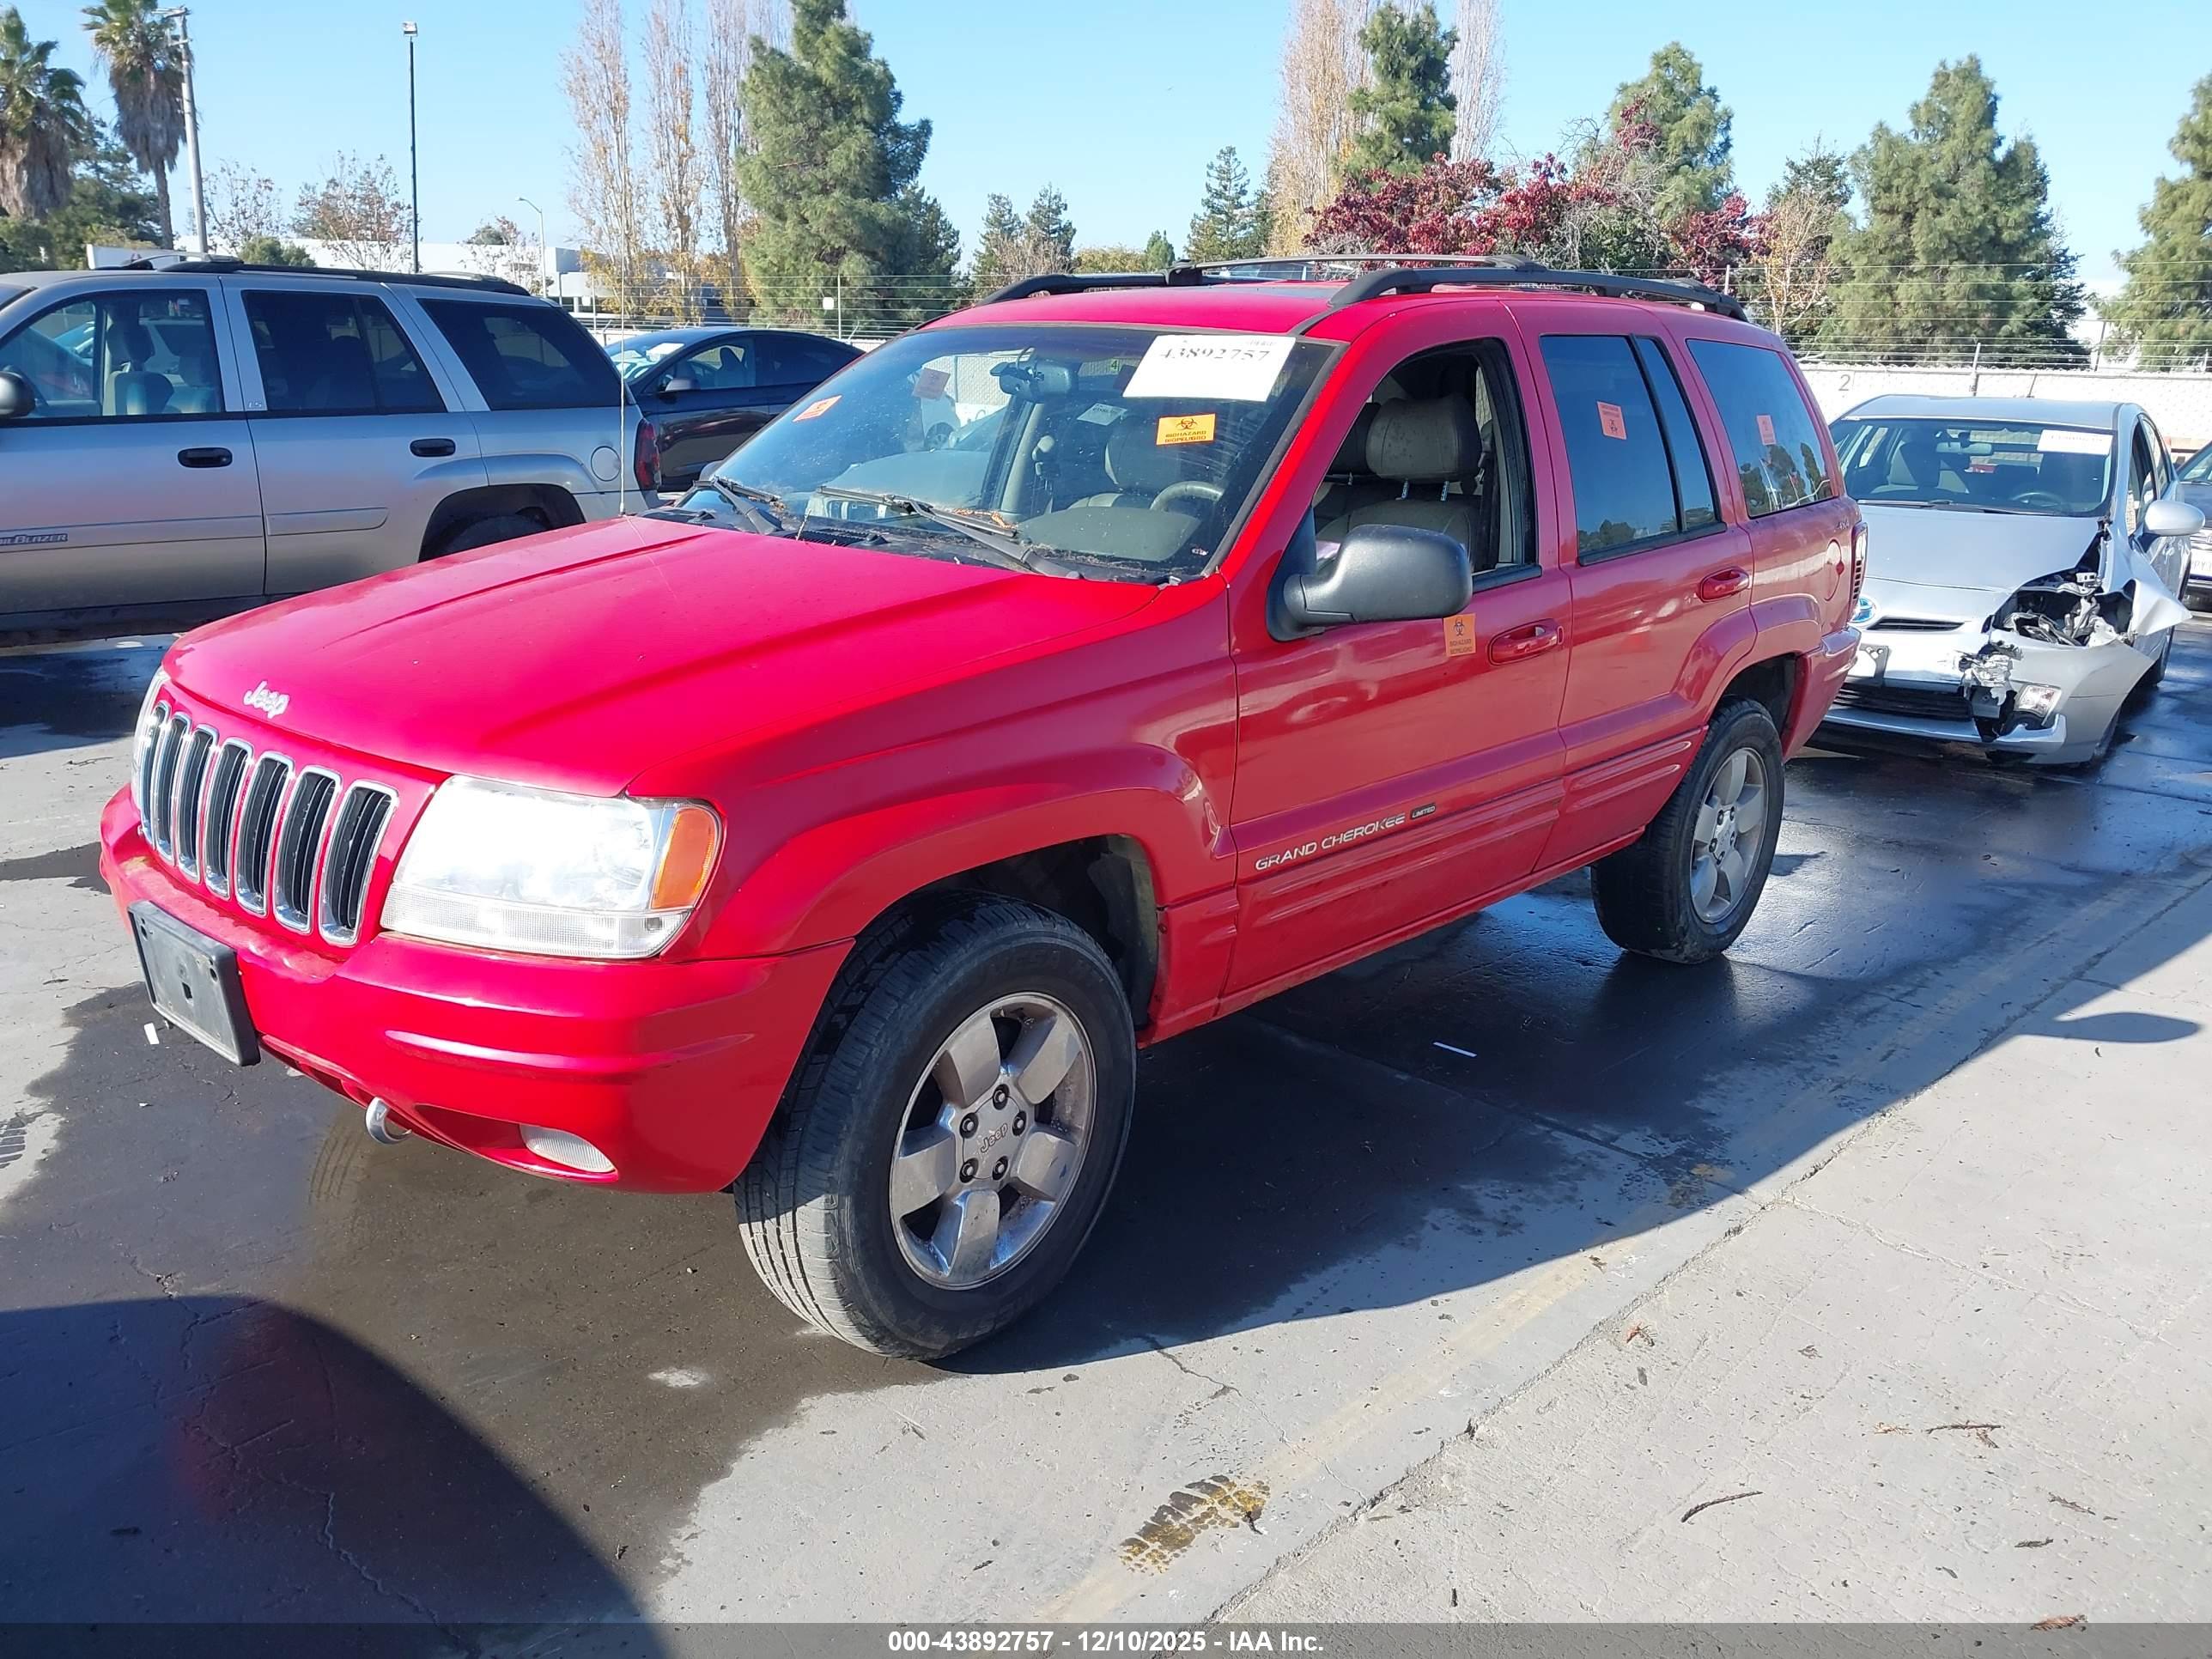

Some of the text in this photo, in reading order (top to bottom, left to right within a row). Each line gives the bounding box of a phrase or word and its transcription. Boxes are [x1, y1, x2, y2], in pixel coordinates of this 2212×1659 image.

[1110, 360, 1118, 370] 4
[1159, 347, 1272, 362] 43892757
[1838, 374, 1851, 392] 2
[243, 679, 290, 720] Jeep
[1255, 805, 1436, 872] GRAND CHEROKEE LIMITED
[980, 1121, 1008, 1153] Jeep
